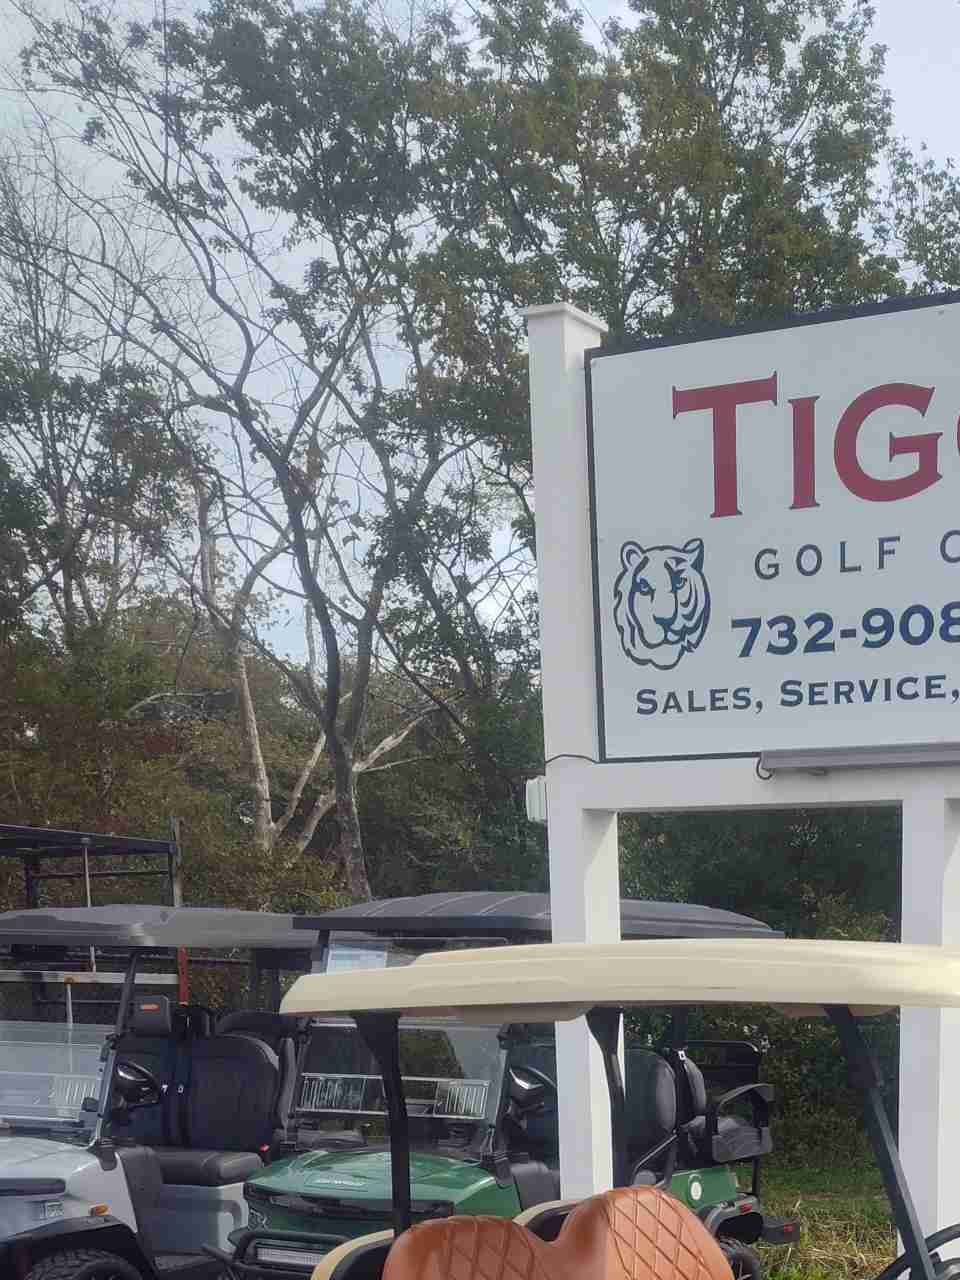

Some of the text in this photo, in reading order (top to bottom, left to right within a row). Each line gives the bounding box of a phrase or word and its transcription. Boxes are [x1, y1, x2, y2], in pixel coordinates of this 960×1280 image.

[754, 535, 903, 581] GOLF
[636, 685, 764, 716] SALES,
[778, 673, 960, 708] SERVICE,
